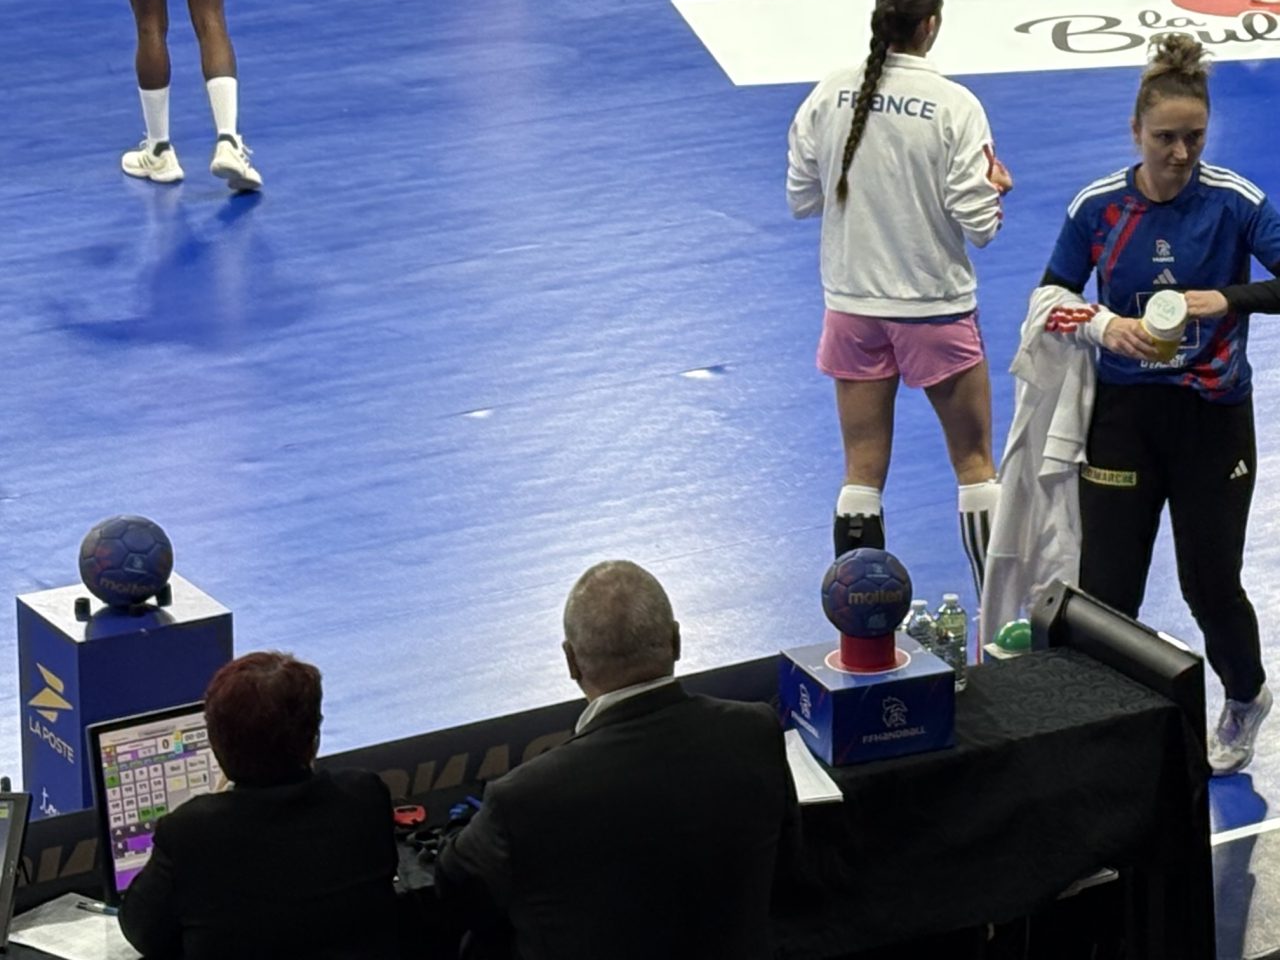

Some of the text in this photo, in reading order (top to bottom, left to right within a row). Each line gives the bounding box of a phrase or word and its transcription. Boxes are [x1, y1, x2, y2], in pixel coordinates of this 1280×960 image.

[1136, 9, 1207, 29] la
[28, 714, 75, 764] LA POSTE
